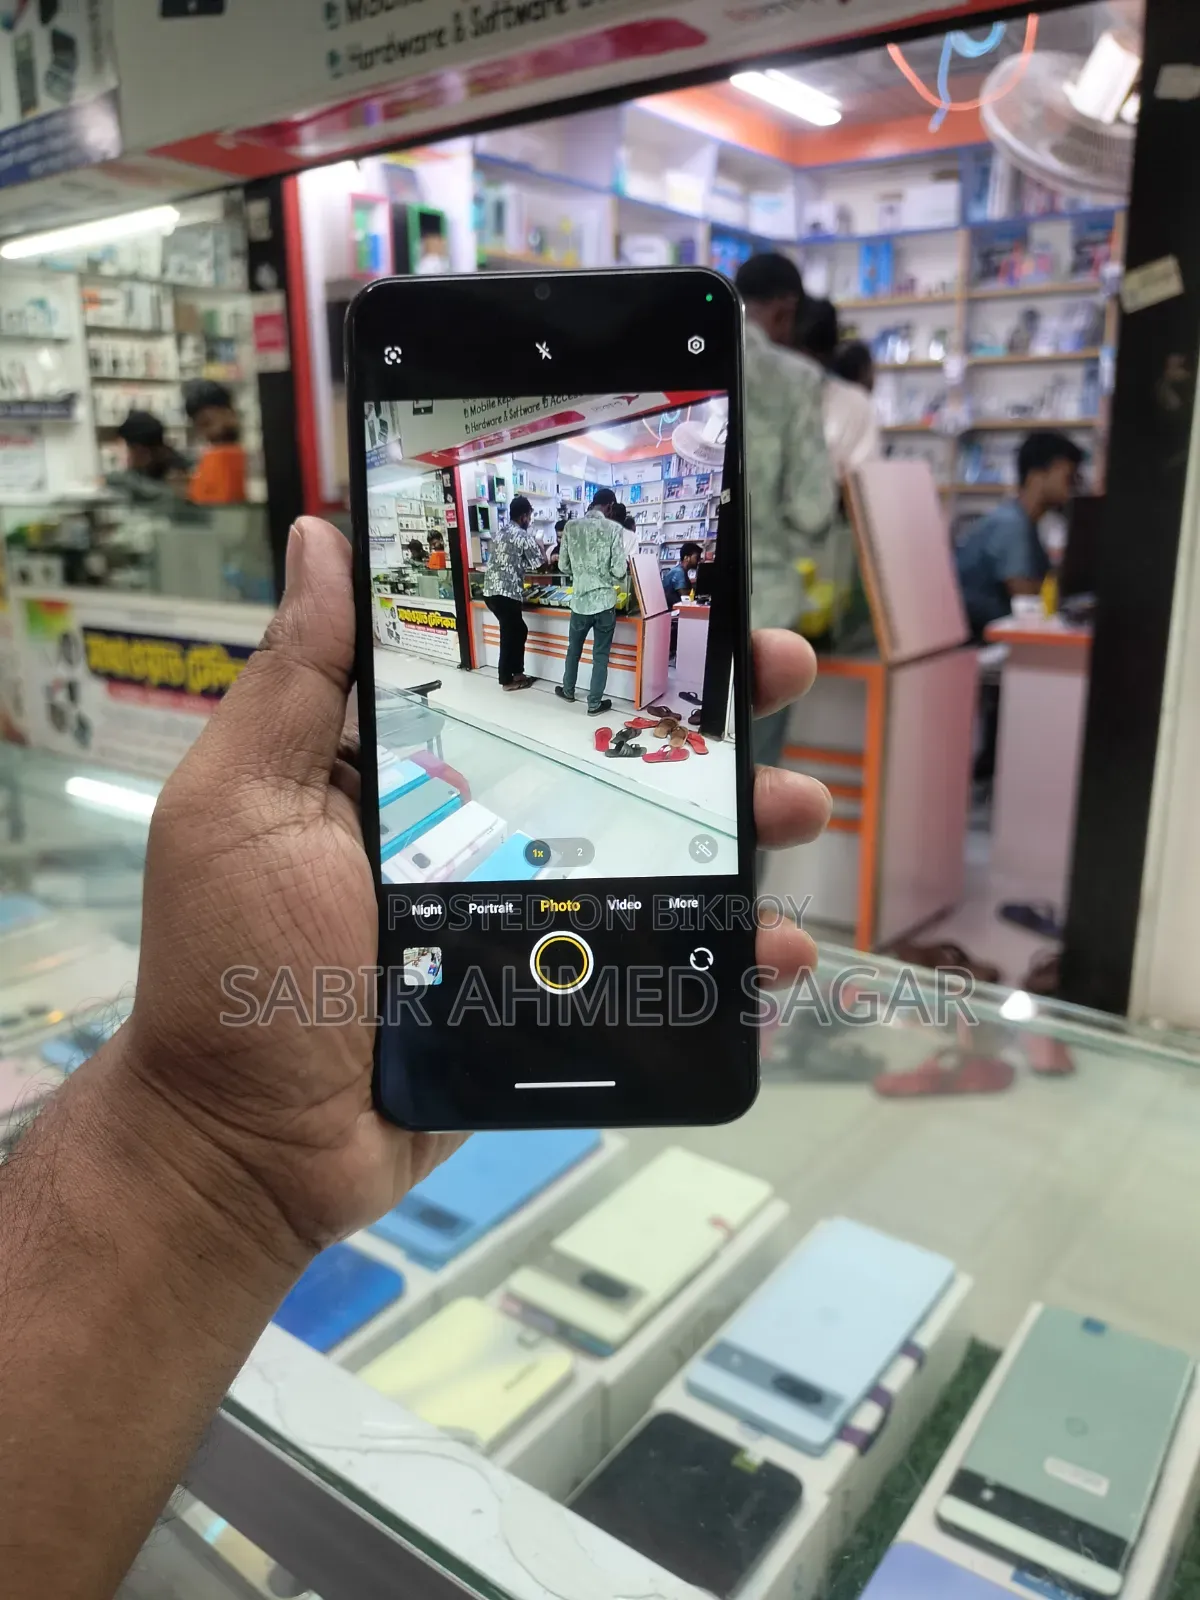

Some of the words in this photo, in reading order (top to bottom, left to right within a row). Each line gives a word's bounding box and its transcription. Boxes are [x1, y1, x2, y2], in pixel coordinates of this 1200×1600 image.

[470, 399, 496, 416] Mobile
[470, 417, 502, 432] Hardware
[509, 402, 541, 420] Software
[532, 848, 544, 858] 1x
[577, 847, 583, 857] 2
[411, 902, 443, 917] Night
[468, 901, 514, 915] Portrait
[540, 899, 581, 912] Photo
[607, 898, 642, 911] Video
[668, 897, 699, 909] More
